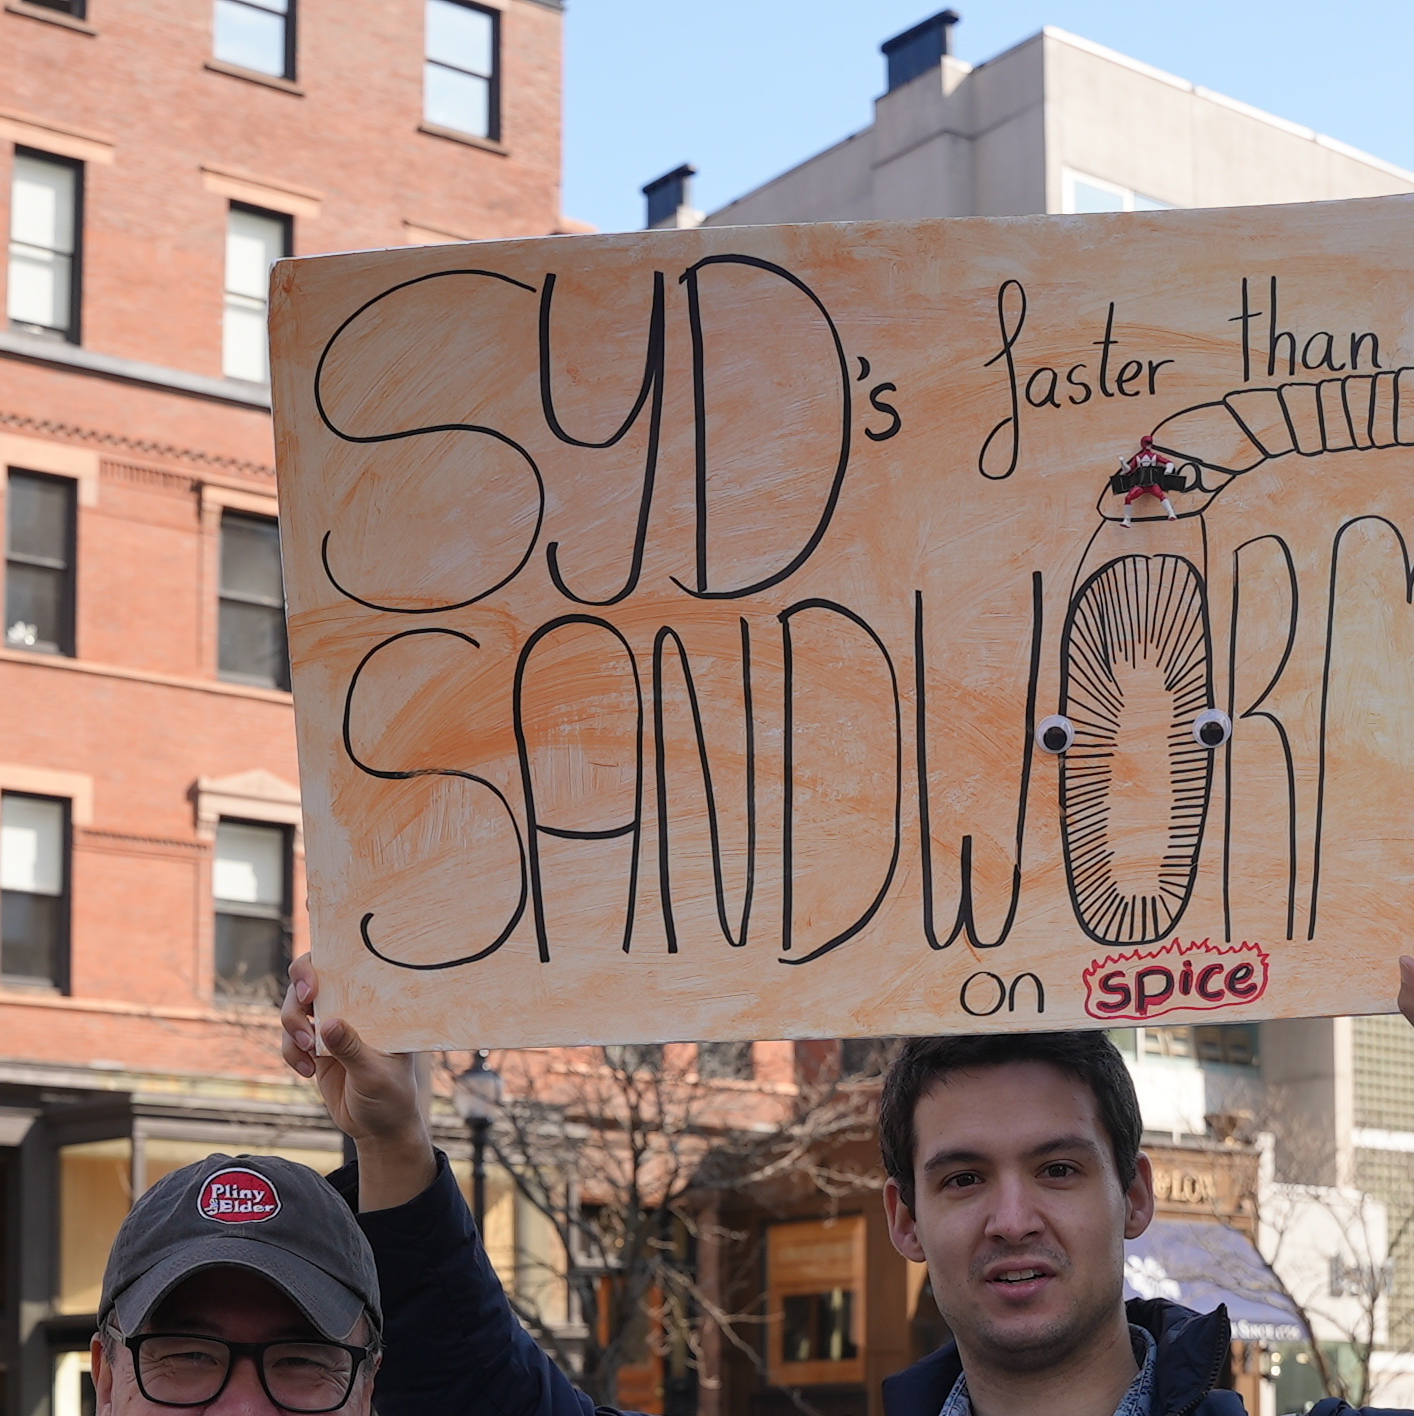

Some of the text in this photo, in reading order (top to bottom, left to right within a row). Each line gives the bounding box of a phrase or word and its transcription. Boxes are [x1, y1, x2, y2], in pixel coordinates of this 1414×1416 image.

[978, 275, 1383, 481] faster than
[314, 253, 902, 612] SYD's
[960, 968, 1046, 1017] on
[210, 1183, 266, 1204] Pliny
[219, 1200, 275, 1214] Elder
